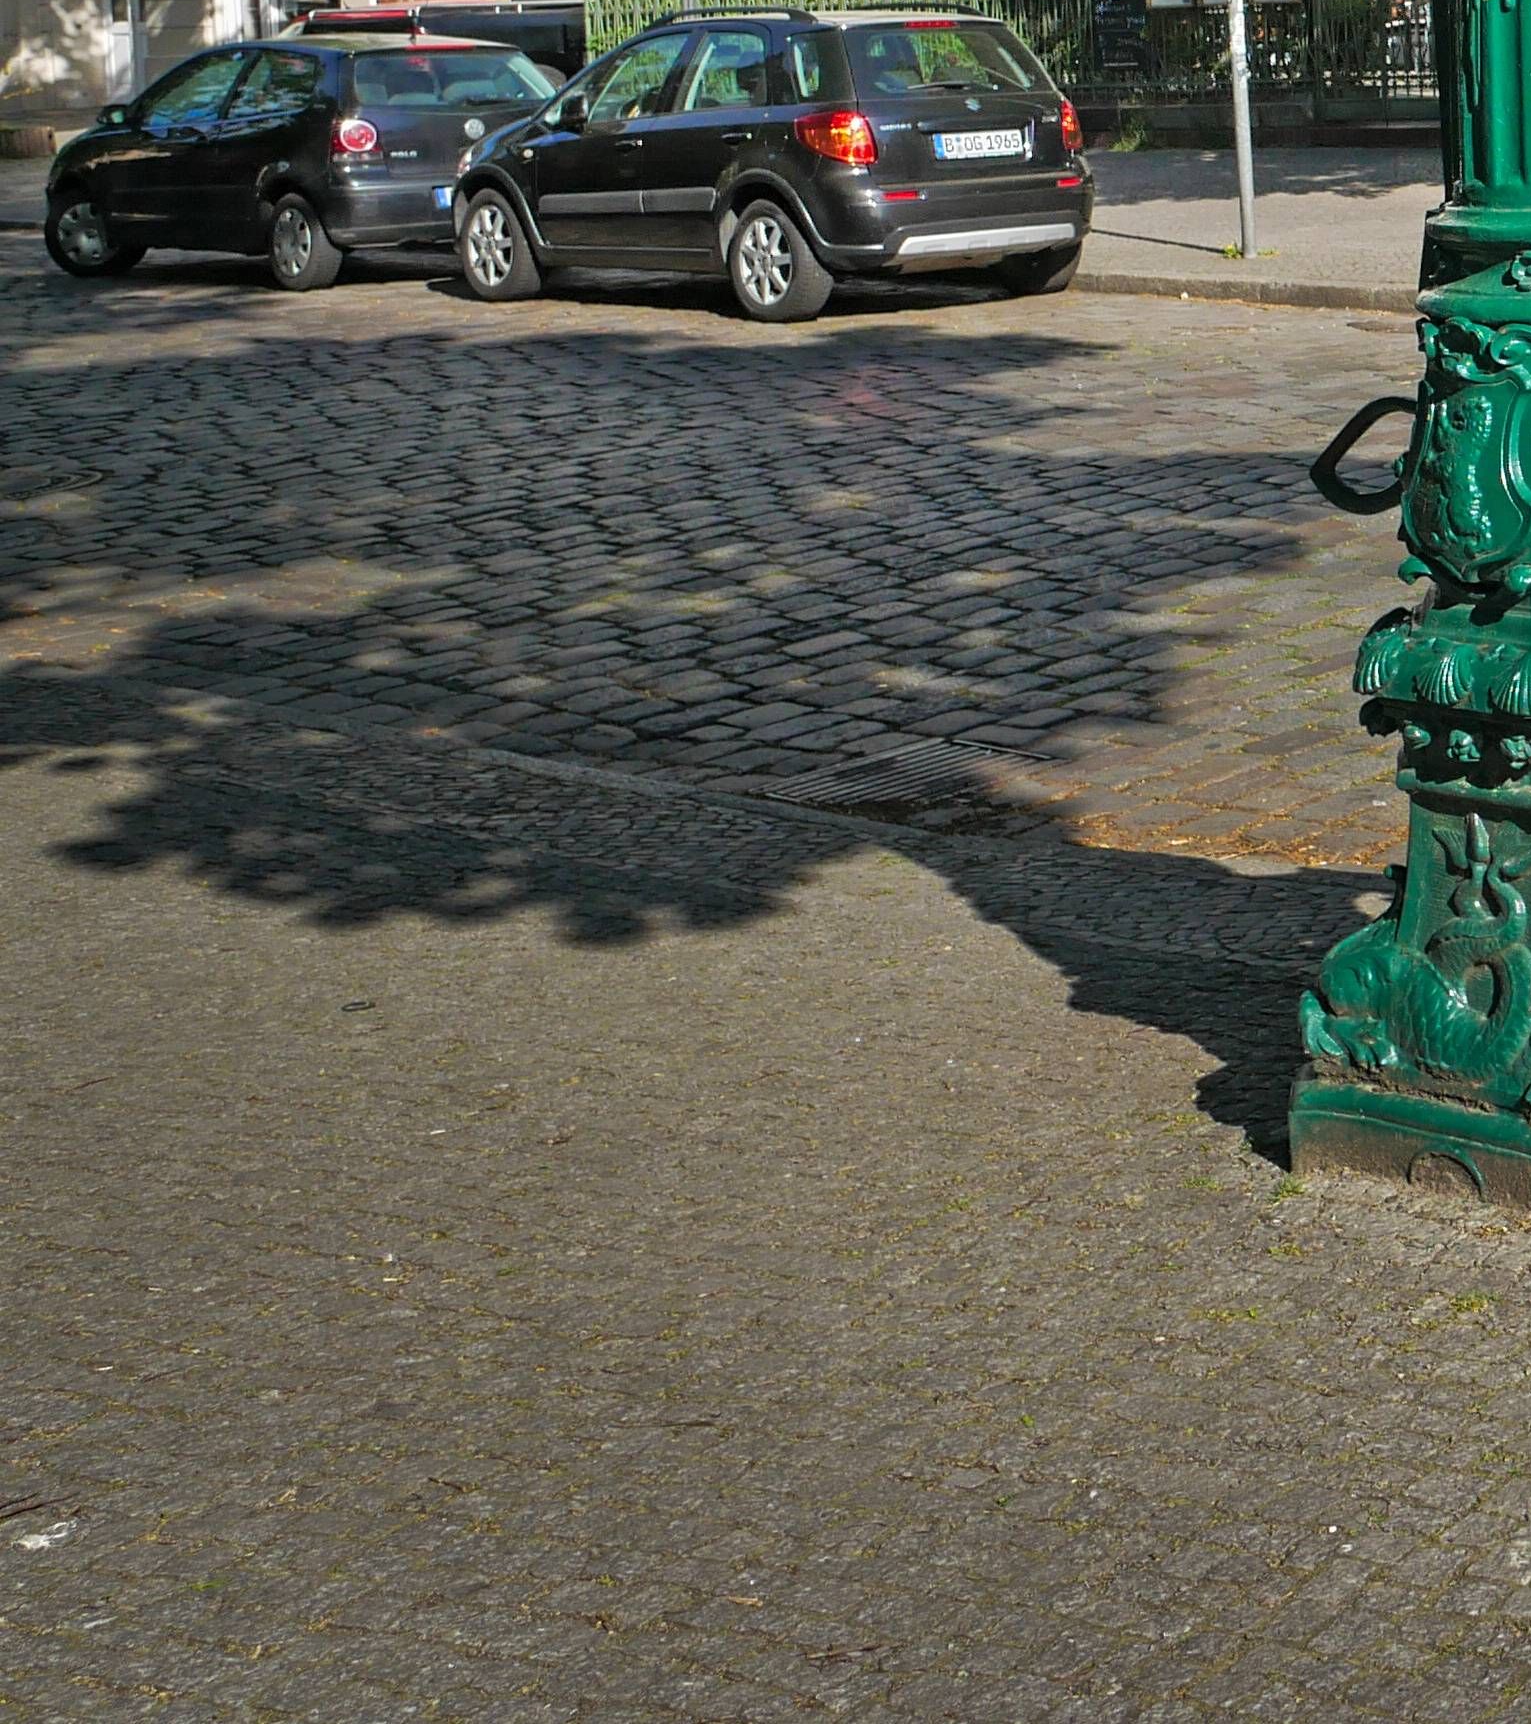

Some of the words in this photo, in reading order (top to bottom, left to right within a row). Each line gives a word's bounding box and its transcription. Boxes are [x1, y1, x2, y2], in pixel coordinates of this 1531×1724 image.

[945, 138, 955, 152] B
[964, 136, 984, 151] OG
[986, 133, 1020, 150] 1965
